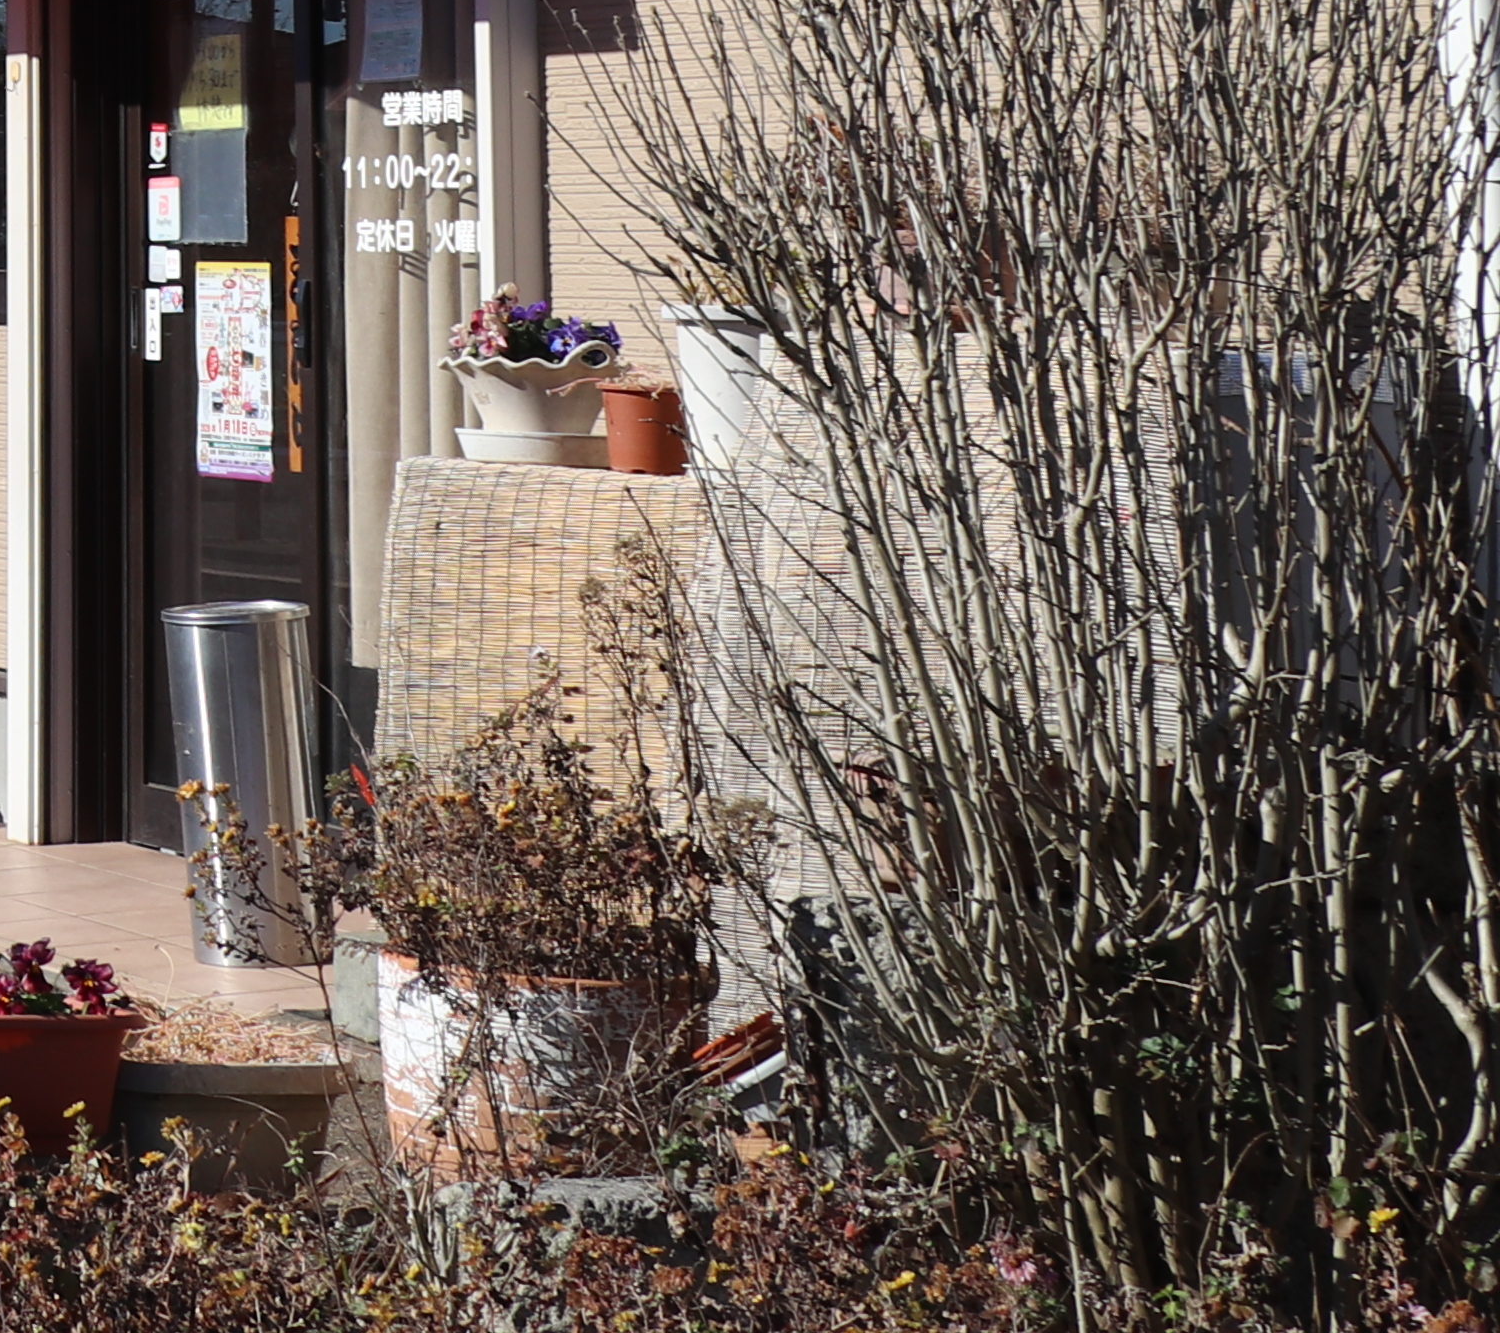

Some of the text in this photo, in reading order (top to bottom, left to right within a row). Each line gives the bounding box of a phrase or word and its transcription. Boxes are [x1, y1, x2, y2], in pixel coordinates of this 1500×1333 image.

[381, 89, 464, 126] 営業時間
[342, 153, 473, 189] 11:00~22:
[356, 219, 481, 253] 定休日 火曜
